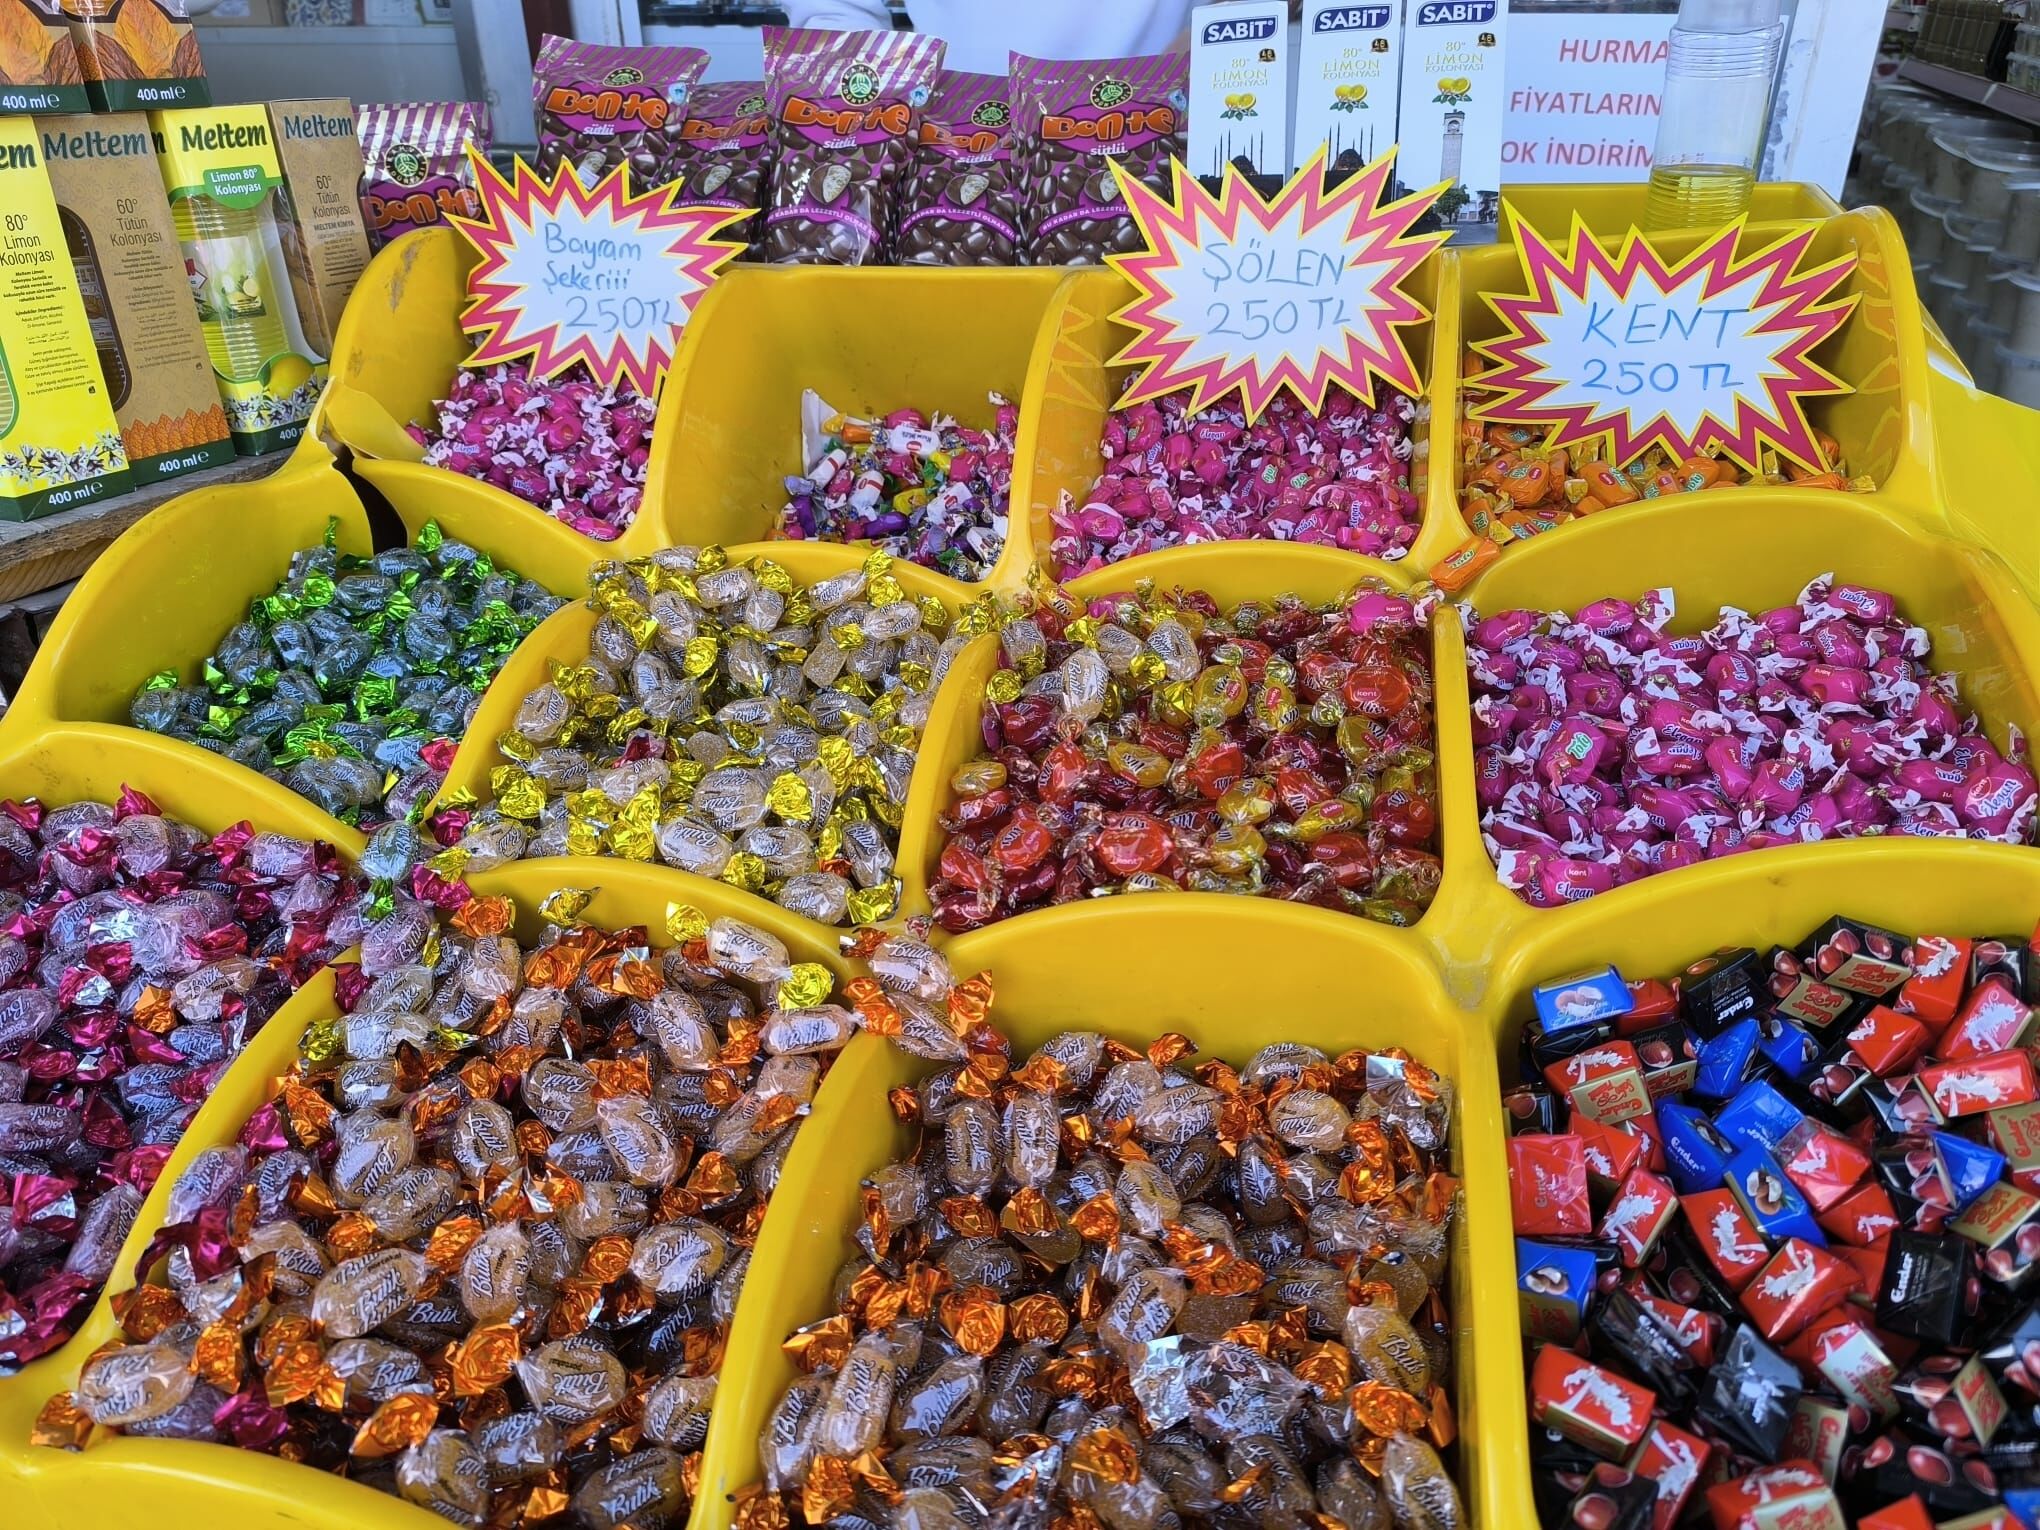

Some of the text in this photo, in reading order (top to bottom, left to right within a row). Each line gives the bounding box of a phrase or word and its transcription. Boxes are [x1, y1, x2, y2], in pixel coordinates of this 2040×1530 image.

[1322, 58, 1380, 73] LİMON
[1425, 52, 1484, 66] LİMON
[1212, 69, 1268, 82] LİMON
[1322, 70, 1380, 81] KOLONYASI
[1424, 62, 1484, 74] KOLONYASI
[1212, 79, 1268, 90] KOLONYASI
[2, 95, 27, 109] 400
[137, 88, 159, 101] 400
[545, 88, 668, 129] Bonte
[783, 96, 911, 136] Bonte
[283, 114, 354, 141] Meltem
[582, 123, 616, 136] sütlü
[1041, 107, 1175, 141] Bonte
[180, 122, 269, 152] Meltem
[822, 136, 858, 149] sütlü
[43, 130, 147, 161] Meltem
[1089, 142, 1128, 156] sütlü
[211, 171, 242, 184] Limon
[214, 181, 262, 196] Kolonyası
[317, 191, 341, 204] Tütün
[312, 204, 351, 218] Kolonyası
[360, 188, 482, 229] Bonte
[116, 218, 149, 232] Tütün
[4, 235, 41, 250] Limon
[109, 231, 163, 247] Kolonyası
[544, 222, 642, 270] Bayram
[0, 249, 55, 267] Kolonyası
[1201, 238, 1346, 293] ŞÖLEN
[1582, 301, 1750, 349] KENT
[279, 427, 298, 441] 400
[159, 460, 181, 474] 400
[48, 490, 73, 505] 400
[1385, 604, 1404, 613] kent
[1356, 689, 1378, 698] kent
[1315, 846, 1337, 855] kent
[1567, 868, 1588, 878] kent
[1670, 1135, 1701, 1172] Ender
[654, 1229, 701, 1270] Butik
[980, 1259, 1018, 1287] Butik
[406, 1302, 462, 1325] Butik
[552, 1370, 610, 1397] Butik
[846, 1358, 876, 1417] Butik
[919, 1378, 961, 1439] Butik
[600, 1475, 663, 1522] Butik
